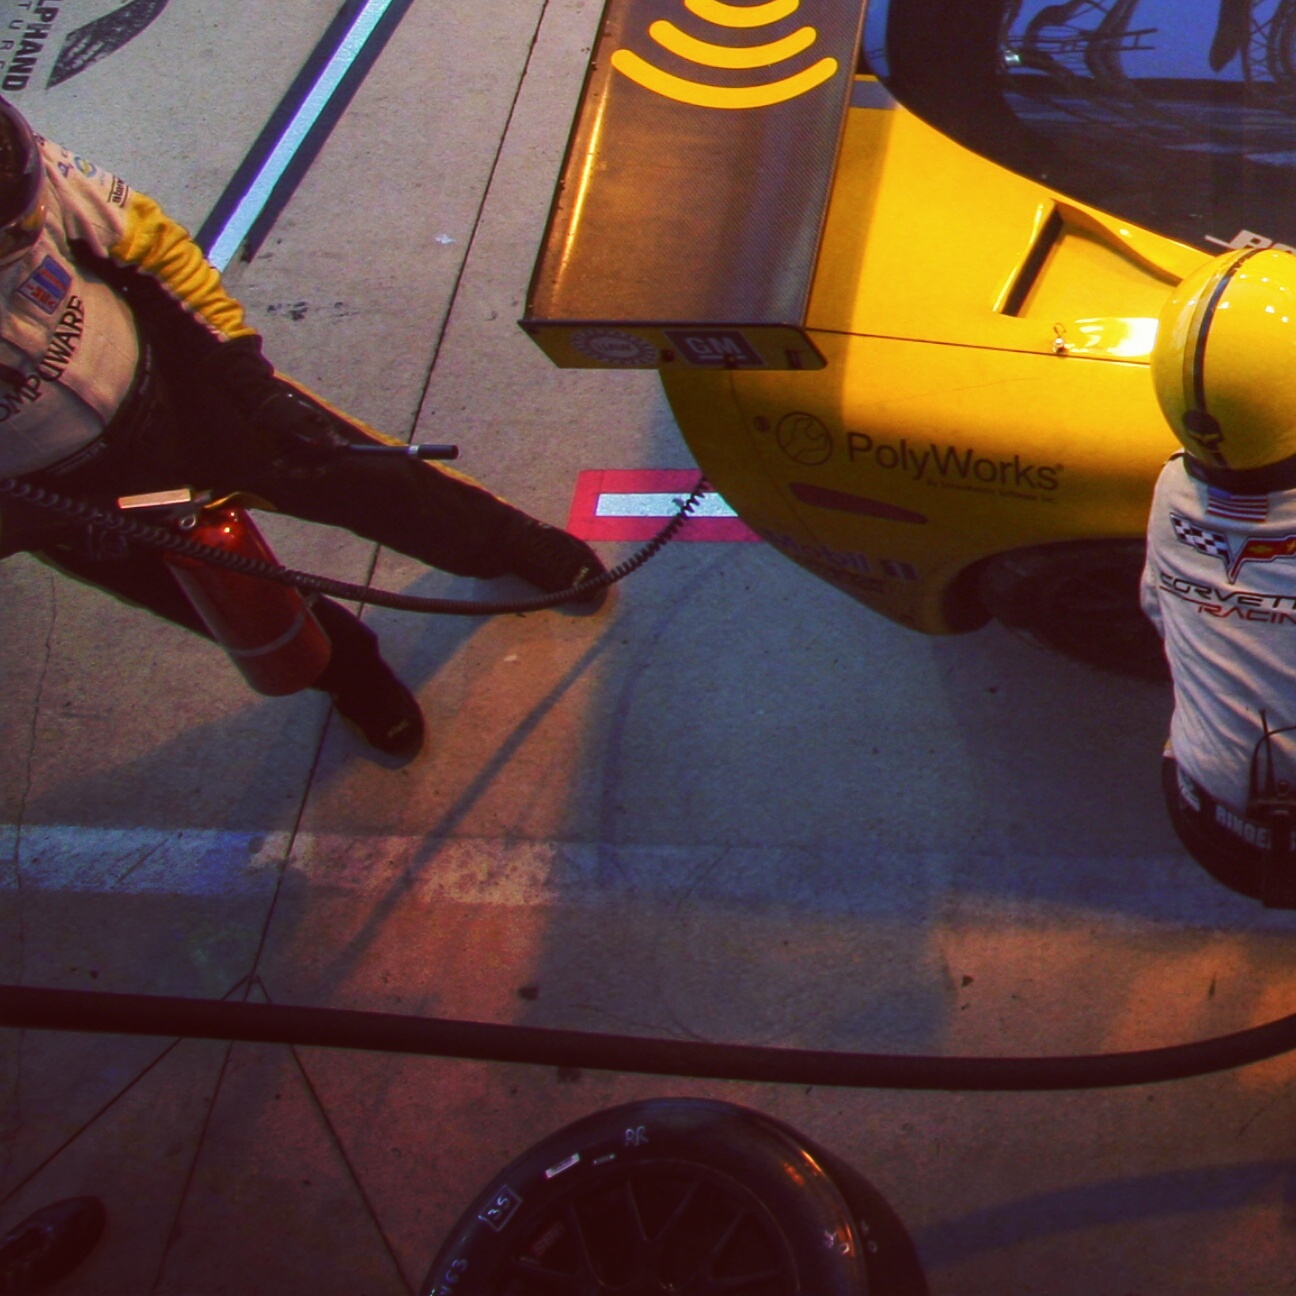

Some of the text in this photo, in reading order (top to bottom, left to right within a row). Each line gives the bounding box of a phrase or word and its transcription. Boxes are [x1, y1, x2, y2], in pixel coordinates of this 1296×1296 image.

[0, 294, 86, 424] OMPUWARE
[684, 336, 743, 355] GM
[845, 430, 1062, 491] PolyWorks
[1214, 802, 1296, 851] RINGES
